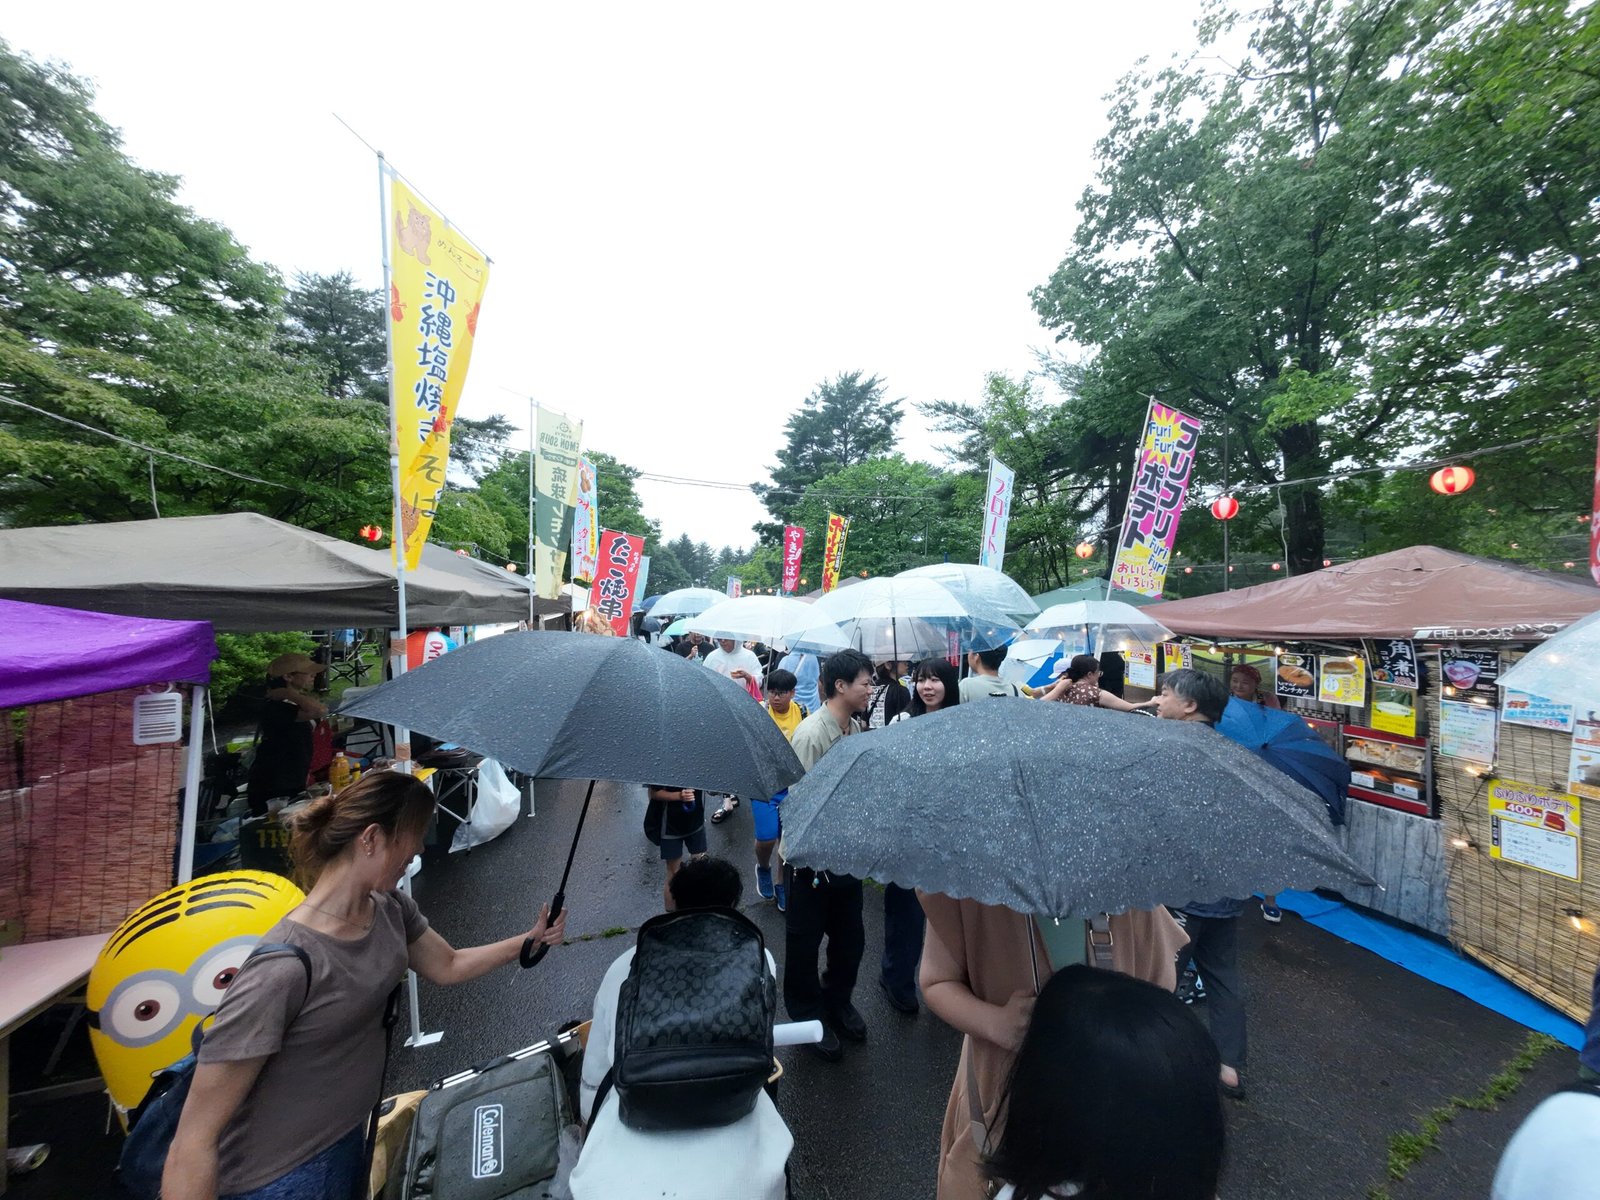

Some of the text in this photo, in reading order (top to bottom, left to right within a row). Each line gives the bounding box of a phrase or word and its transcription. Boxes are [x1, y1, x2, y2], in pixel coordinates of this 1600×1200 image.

[1149, 421, 1172, 438] Furi
[1153, 438, 1174, 453] Furi
[1153, 421, 1200, 540] フリフリ
[988, 477, 1006, 556] フロート
[1124, 461, 1166, 548] ポテト
[787, 530, 802, 576] やきそば
[1149, 537, 1169, 560] Furi
[1147, 553, 1168, 576] Furi
[598, 536, 631, 620] たこ焼串
[1433, 627, 1515, 639] FIELDOOR
[1380, 650, 1391, 670] コロッケ
[1388, 640, 1416, 678] 角煮
[1278, 686, 1309, 696] メンチカツ
[1494, 787, 1576, 815] ふりふりポテト
[1506, 803, 1542, 818] 400円
[482, 1109, 499, 1160] Coleman
